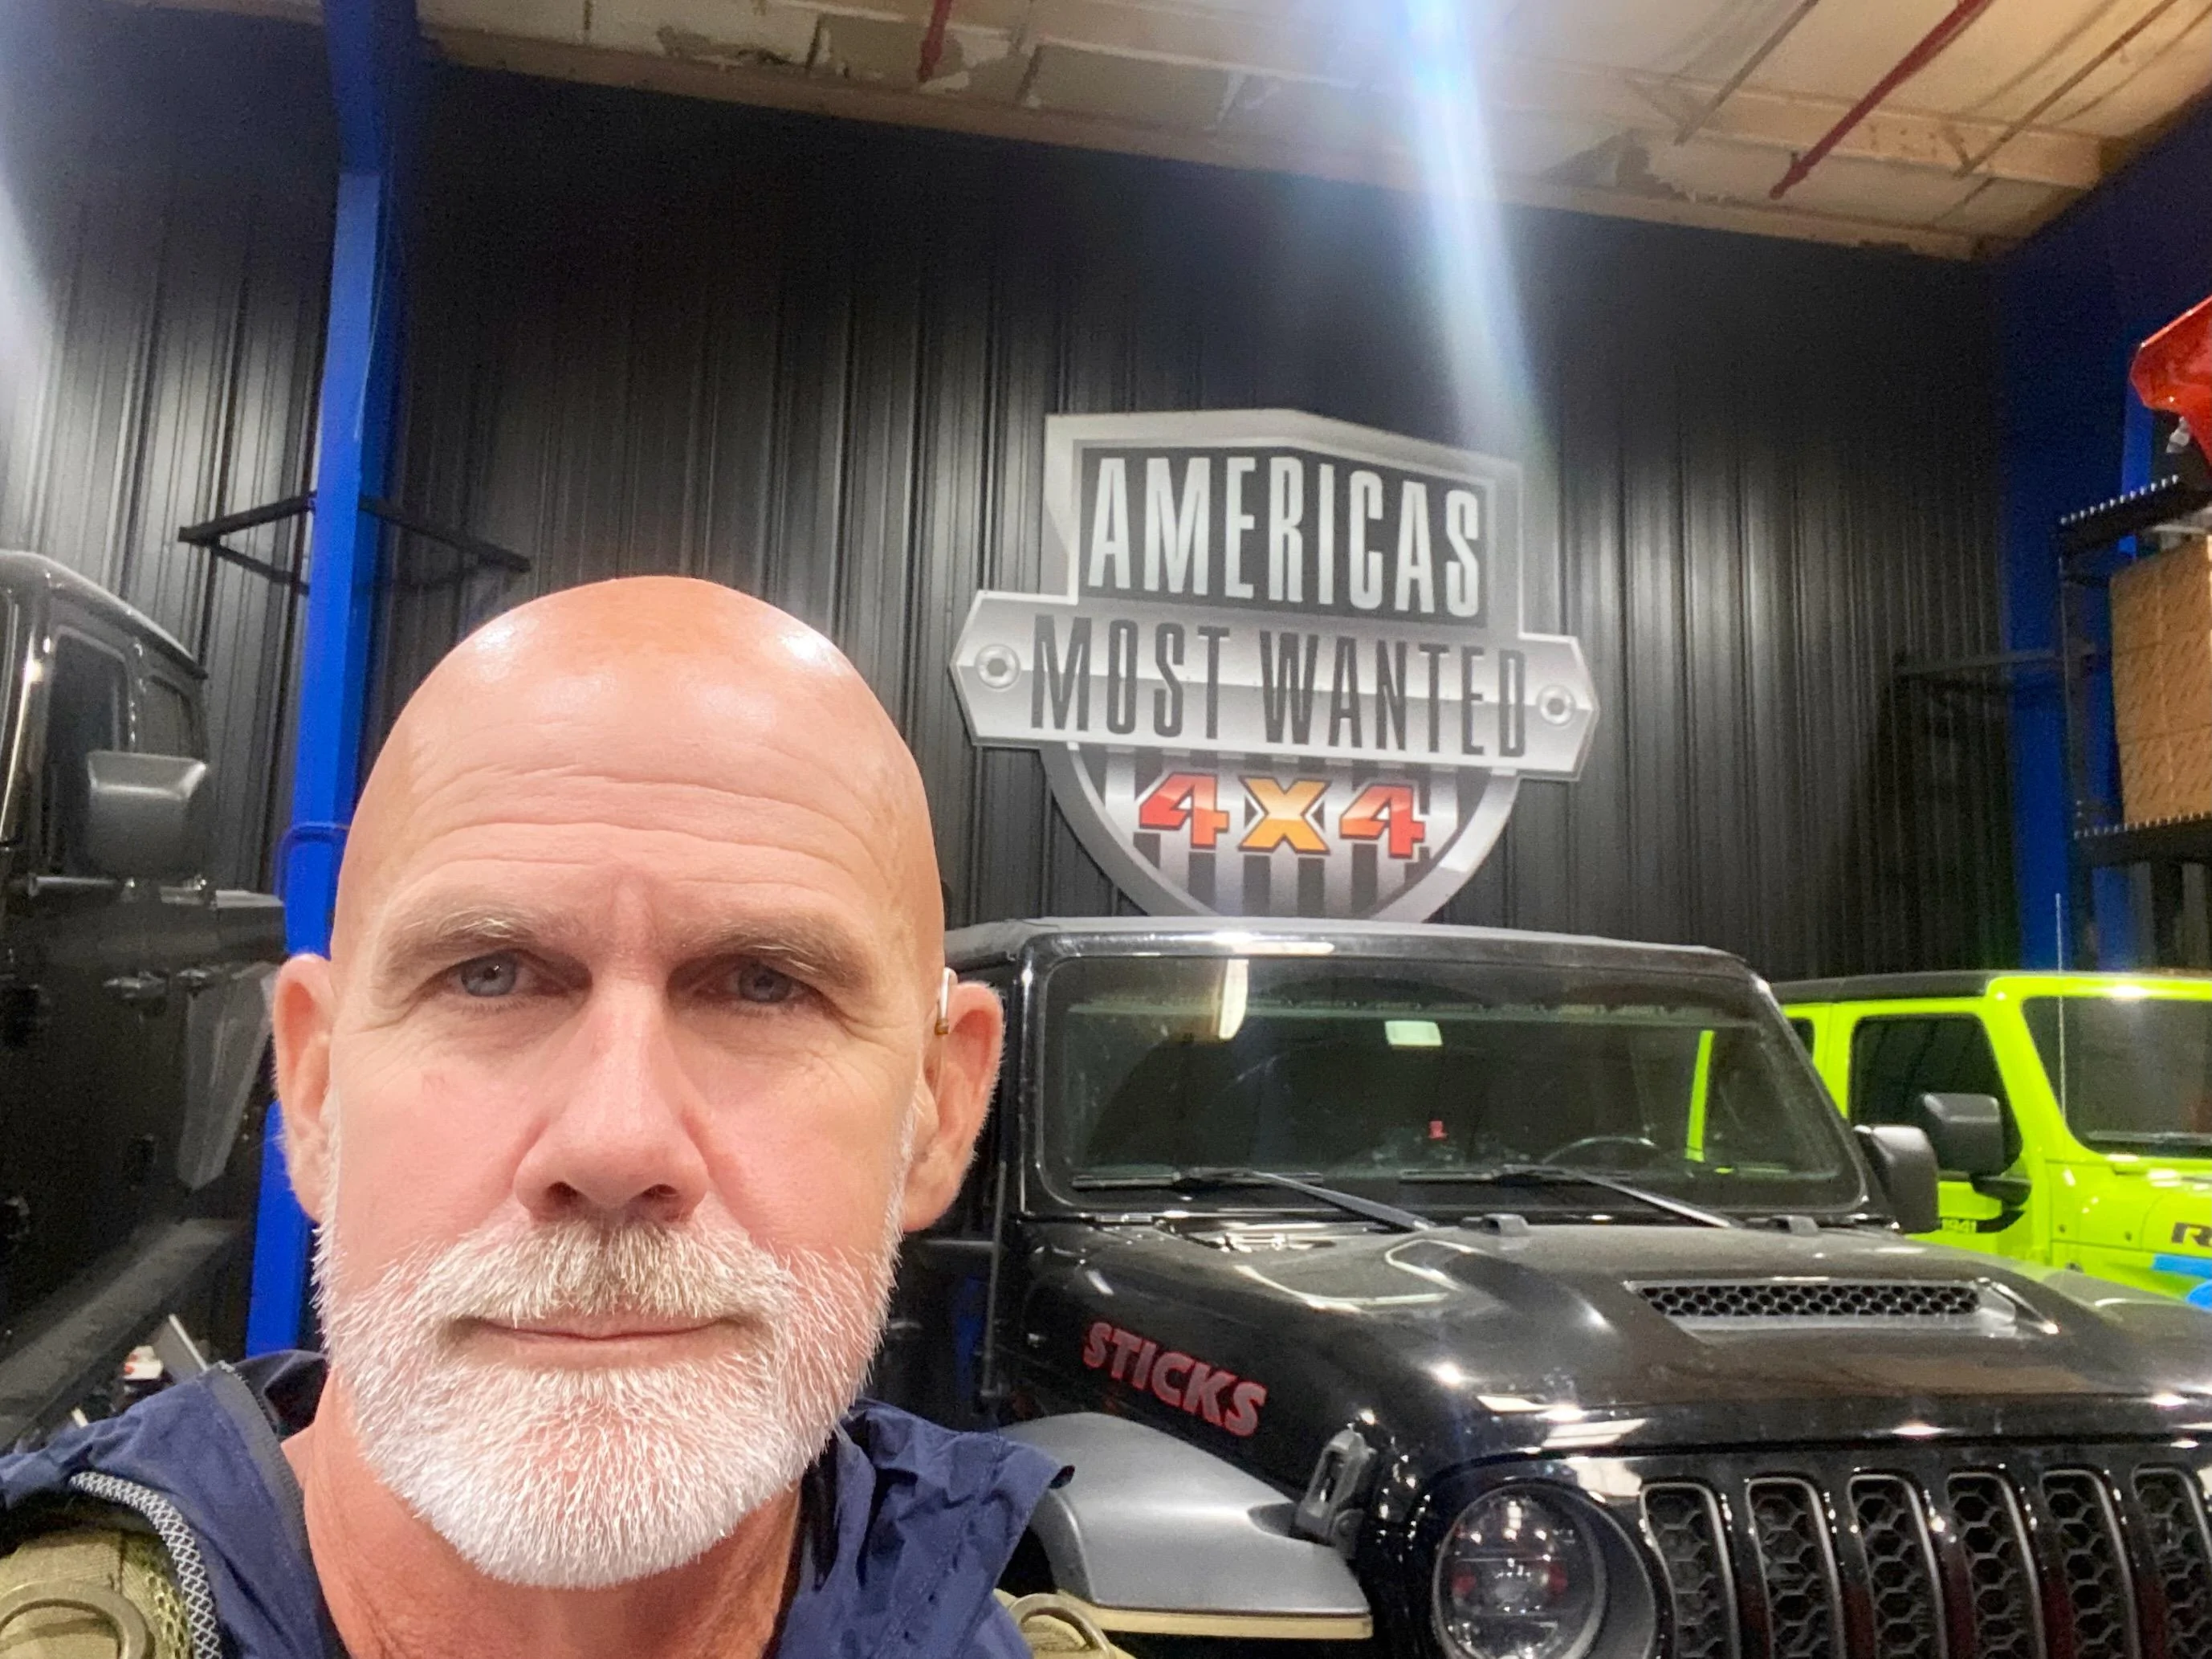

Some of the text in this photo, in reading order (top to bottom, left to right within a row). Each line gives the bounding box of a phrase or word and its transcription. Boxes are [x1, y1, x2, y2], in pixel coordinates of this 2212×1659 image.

[1087, 456, 1481, 618] AMERICAS
[1030, 613, 1527, 758] MOST WANTED
[1082, 1321, 1269, 1437] STICKS
